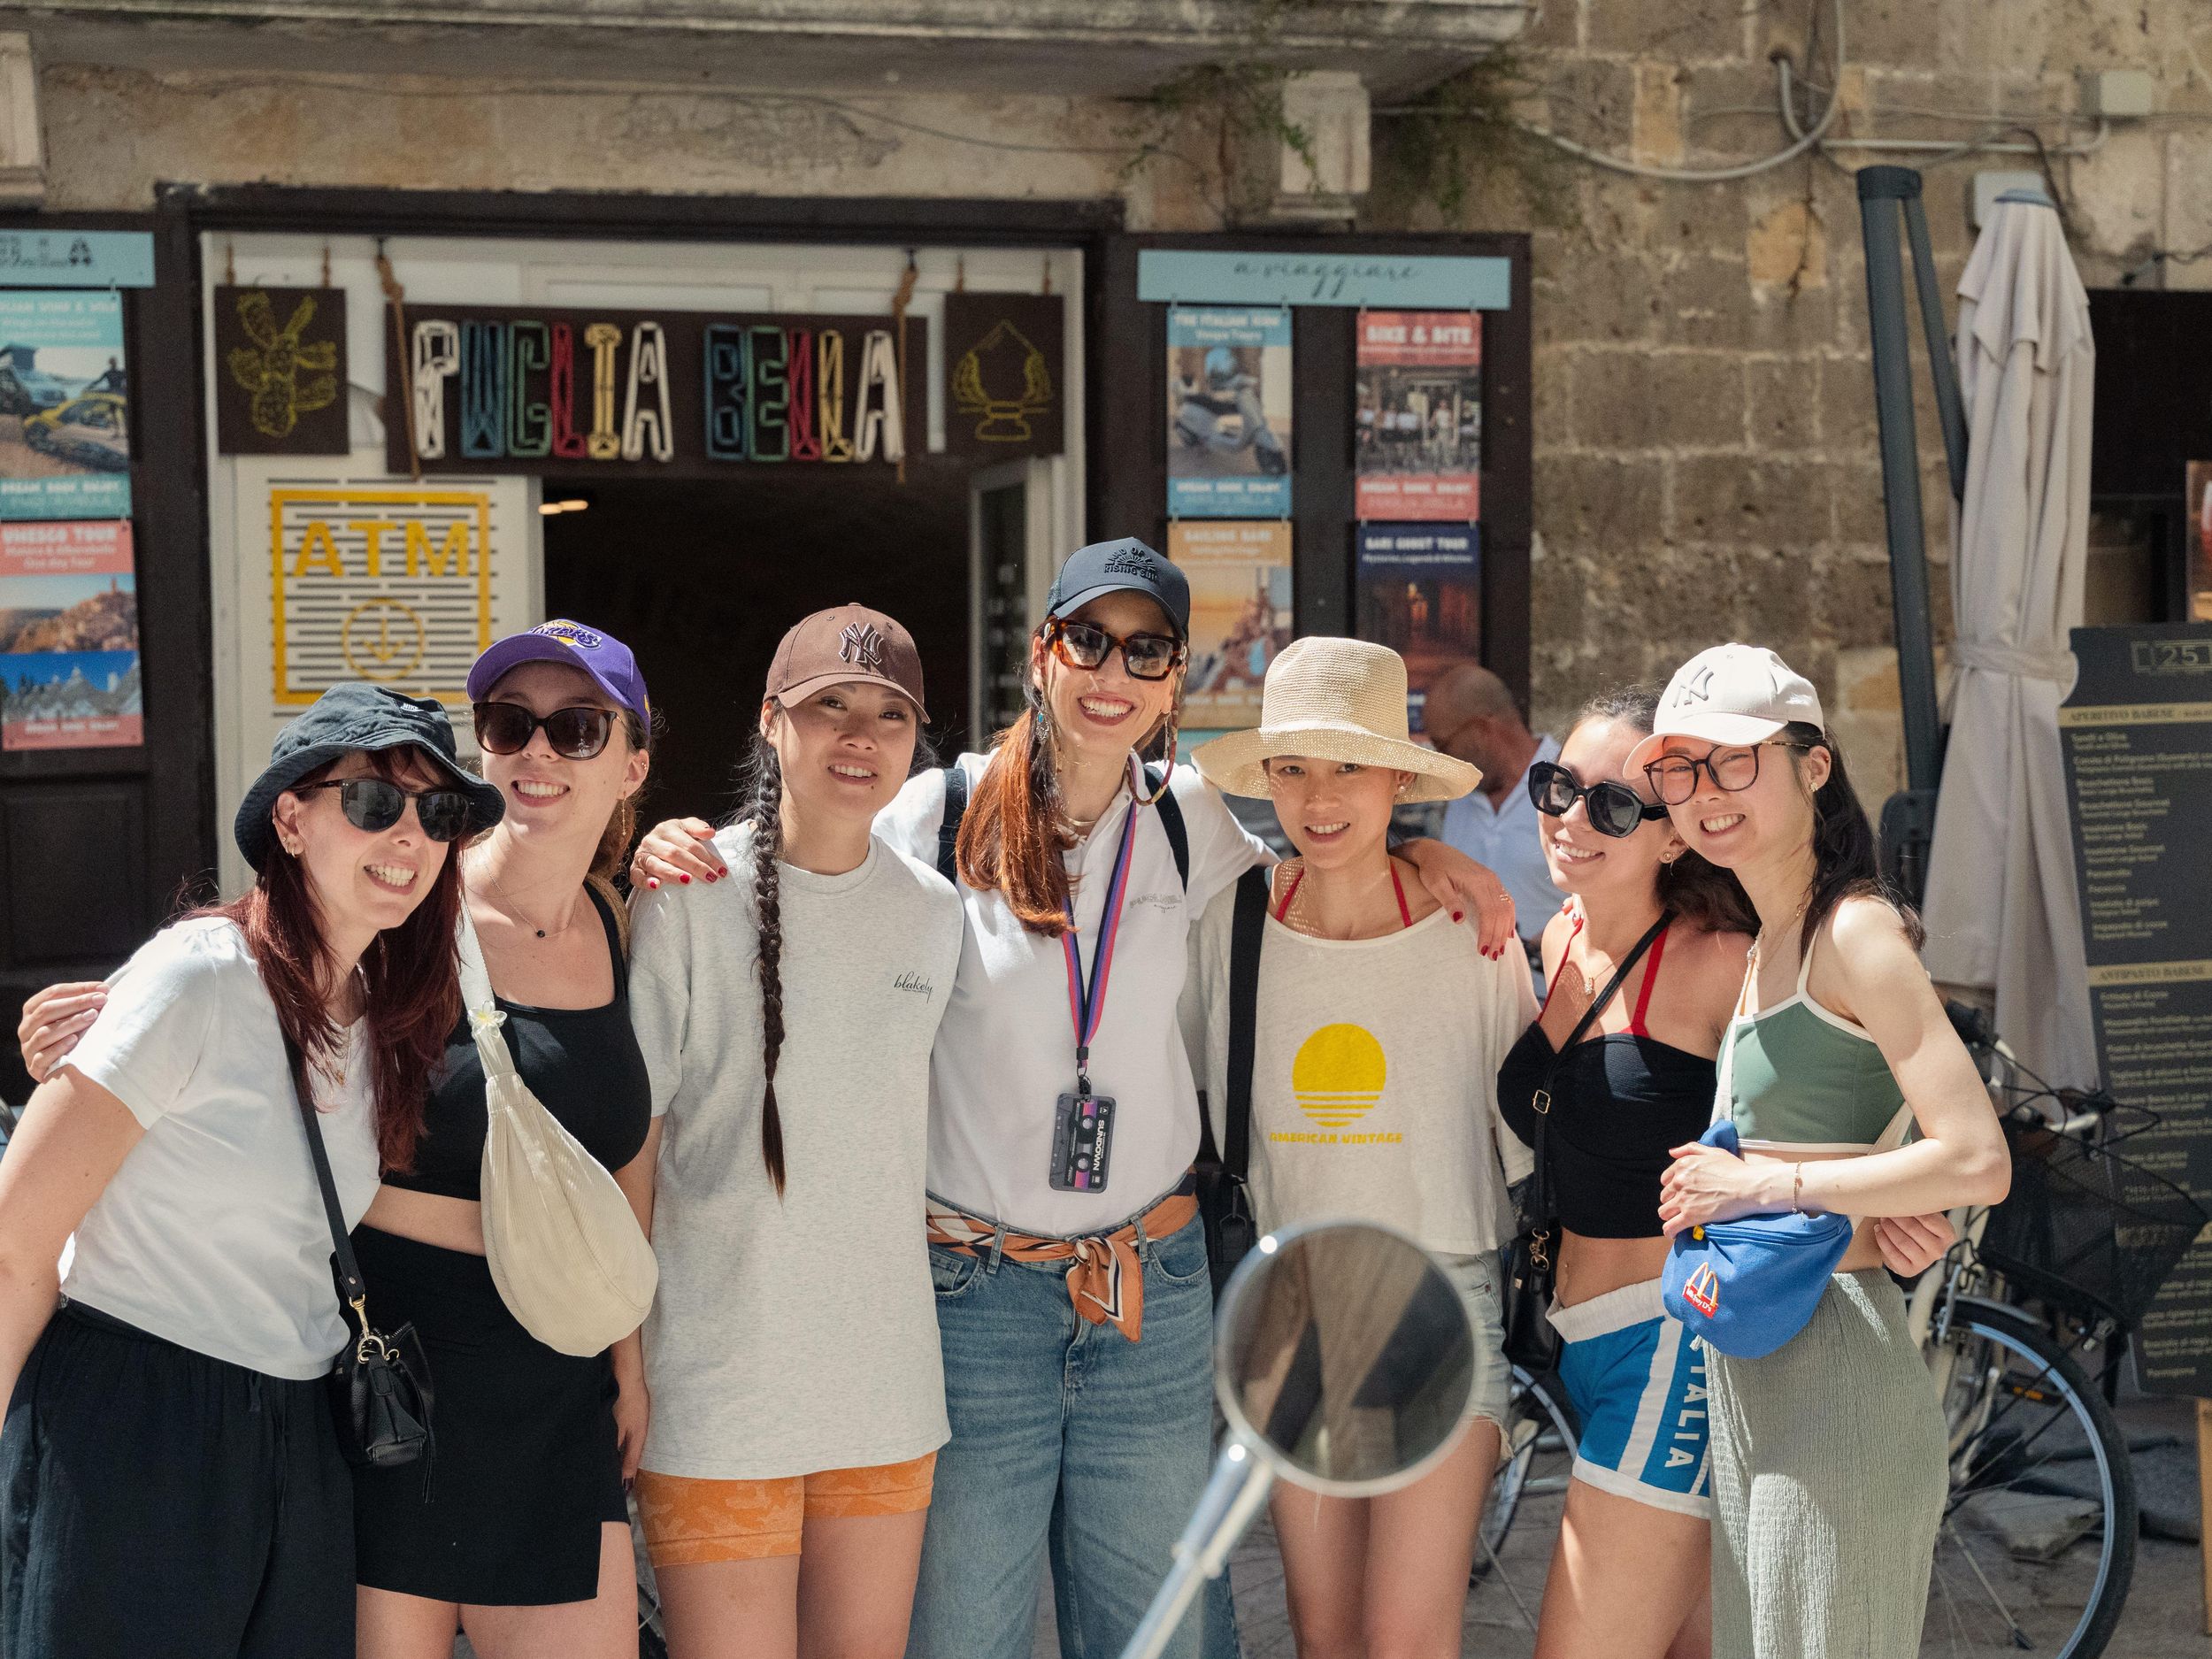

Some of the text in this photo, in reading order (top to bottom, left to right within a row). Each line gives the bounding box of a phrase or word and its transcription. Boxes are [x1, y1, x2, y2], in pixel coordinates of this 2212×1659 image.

[412, 319, 905, 462] PUGLIA BELLA
[292, 521, 469, 577] ATM
[1104, 565, 1138, 575] RISING
[839, 621, 884, 665] NY
[894, 970, 933, 1004] blakely
[1093, 1119, 1105, 1171] SUNDOWN
[1269, 1132, 1402, 1144] AMERICAN VINTAGE
